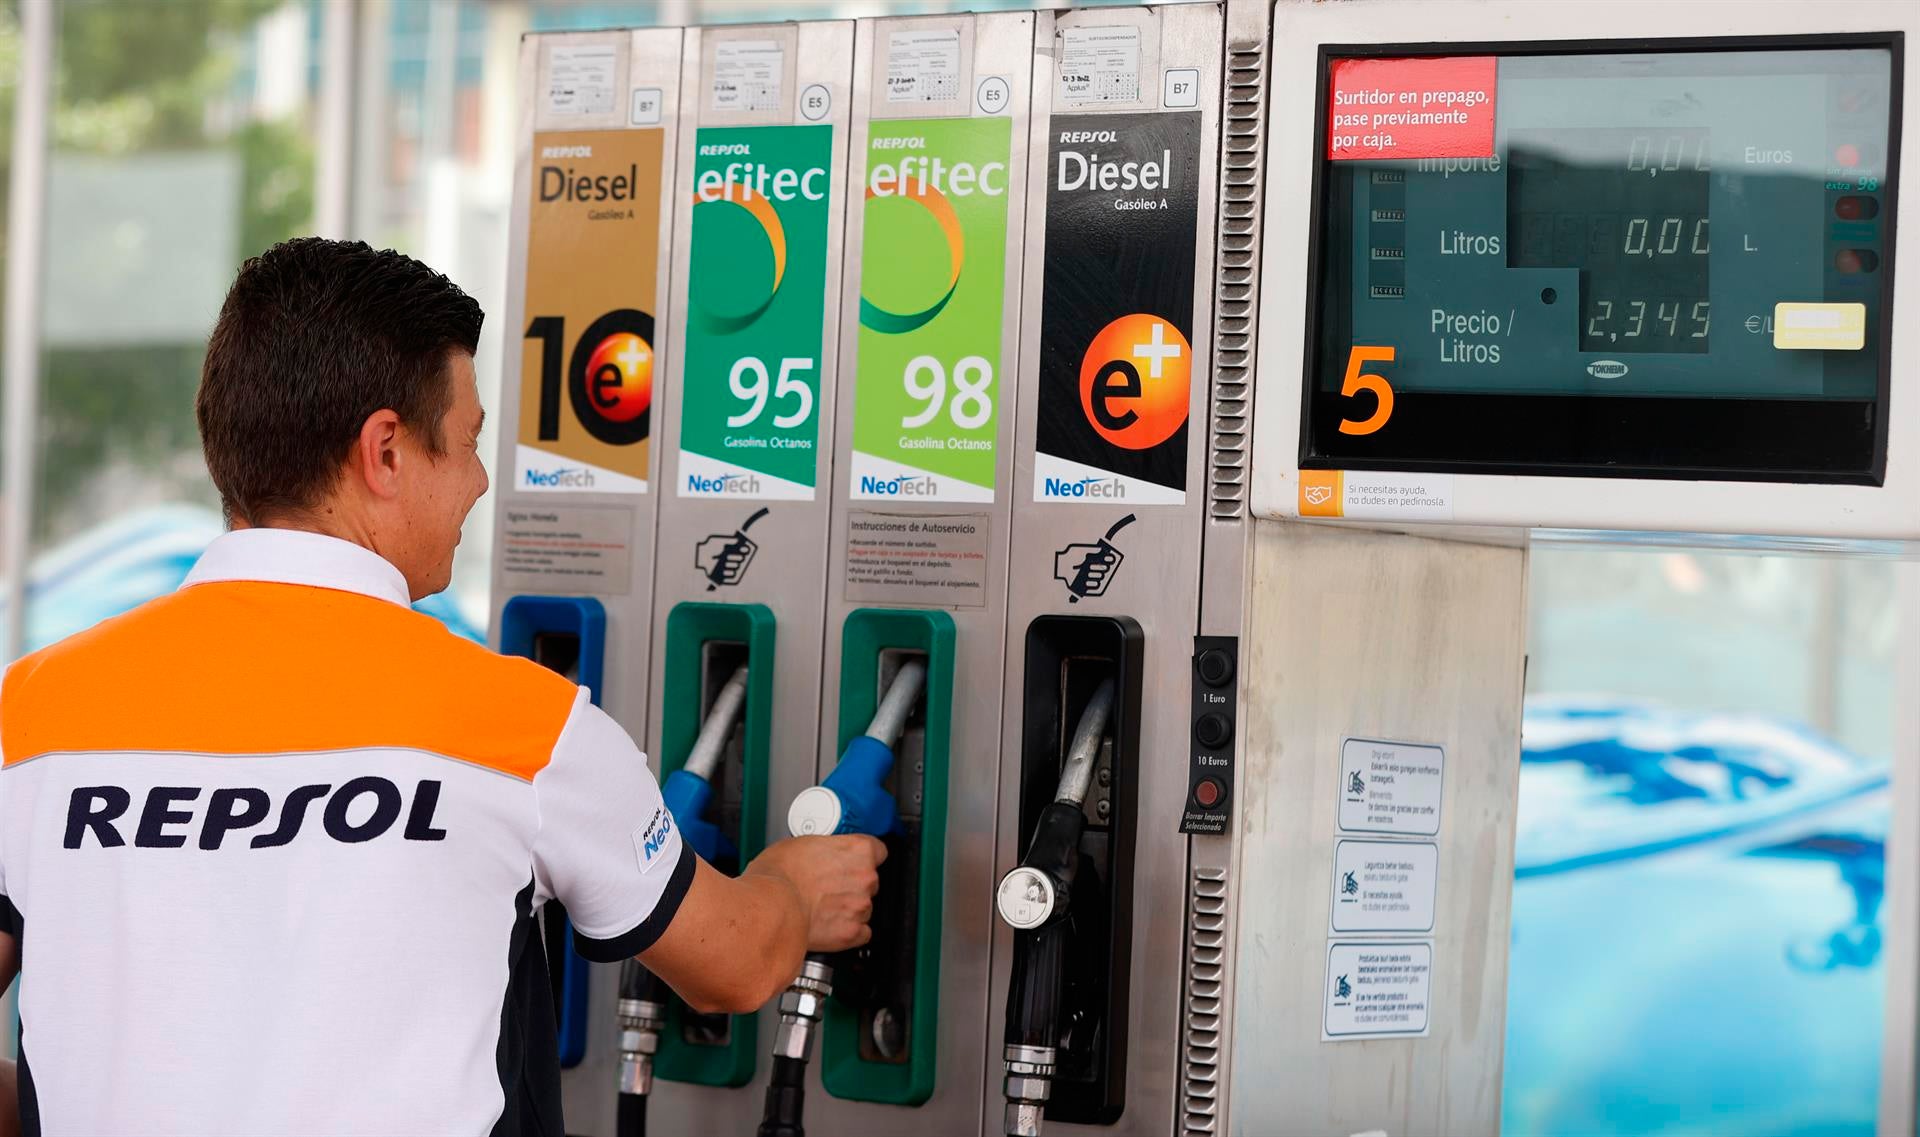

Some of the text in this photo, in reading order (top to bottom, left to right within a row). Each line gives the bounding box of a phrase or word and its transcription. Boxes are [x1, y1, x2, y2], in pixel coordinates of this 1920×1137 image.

[986, 90, 1000, 101] E5
[1173, 83, 1189, 94] B7
[640, 101, 654, 112] B7
[809, 97, 822, 109] E5
[1334, 89, 1489, 110] Surtidor en prepago,
[1333, 109, 1468, 133] pase previamente
[871, 137, 927, 149] REPSOL
[1060, 131, 1118, 144] REPSOL
[1332, 132, 1397, 153] por caja.
[541, 145, 593, 158] REPSOL
[699, 144, 751, 156] REPSOL
[1744, 146, 1793, 164] Euros
[869, 156, 1006, 197] efitec
[1057, 148, 1171, 192] Diesel
[539, 163, 637, 203] Diesel
[697, 163, 826, 202] efitec
[1857, 176, 1878, 192] 98
[1114, 199, 1169, 211] Gasóleo A
[626, 209, 635, 220] A
[1440, 230, 1500, 255] Litros
[1744, 233, 1759, 252] L.
[1431, 309, 1515, 337] Precio /
[1440, 338, 1500, 363] Litros
[726, 355, 814, 429] 95
[901, 355, 993, 429] 98
[1338, 345, 1396, 436] 5
[724, 436, 812, 448] Gasolina Octanos
[899, 437, 992, 450] Gasolina Octanos
[525, 468, 595, 488] NeoTech
[687, 475, 761, 494] NeoTech
[860, 476, 937, 496] NeoTech
[1044, 477, 1126, 498] NeoTech
[1348, 484, 1427, 497] Si necesitas ayuda,
[1348, 497, 1358, 505] no
[1361, 496, 1387, 506] dudes
[1388, 498, 1399, 506] en
[851, 521, 976, 534] Instrucciones de Autoservicio
[1209, 694, 1226, 704] Euro
[1198, 756, 1228, 767] 10 Euros
[63, 776, 447, 851] REPSOL
[1186, 812, 1227, 822] Borrar Importe
[1185, 822, 1222, 831] Seleccionado
